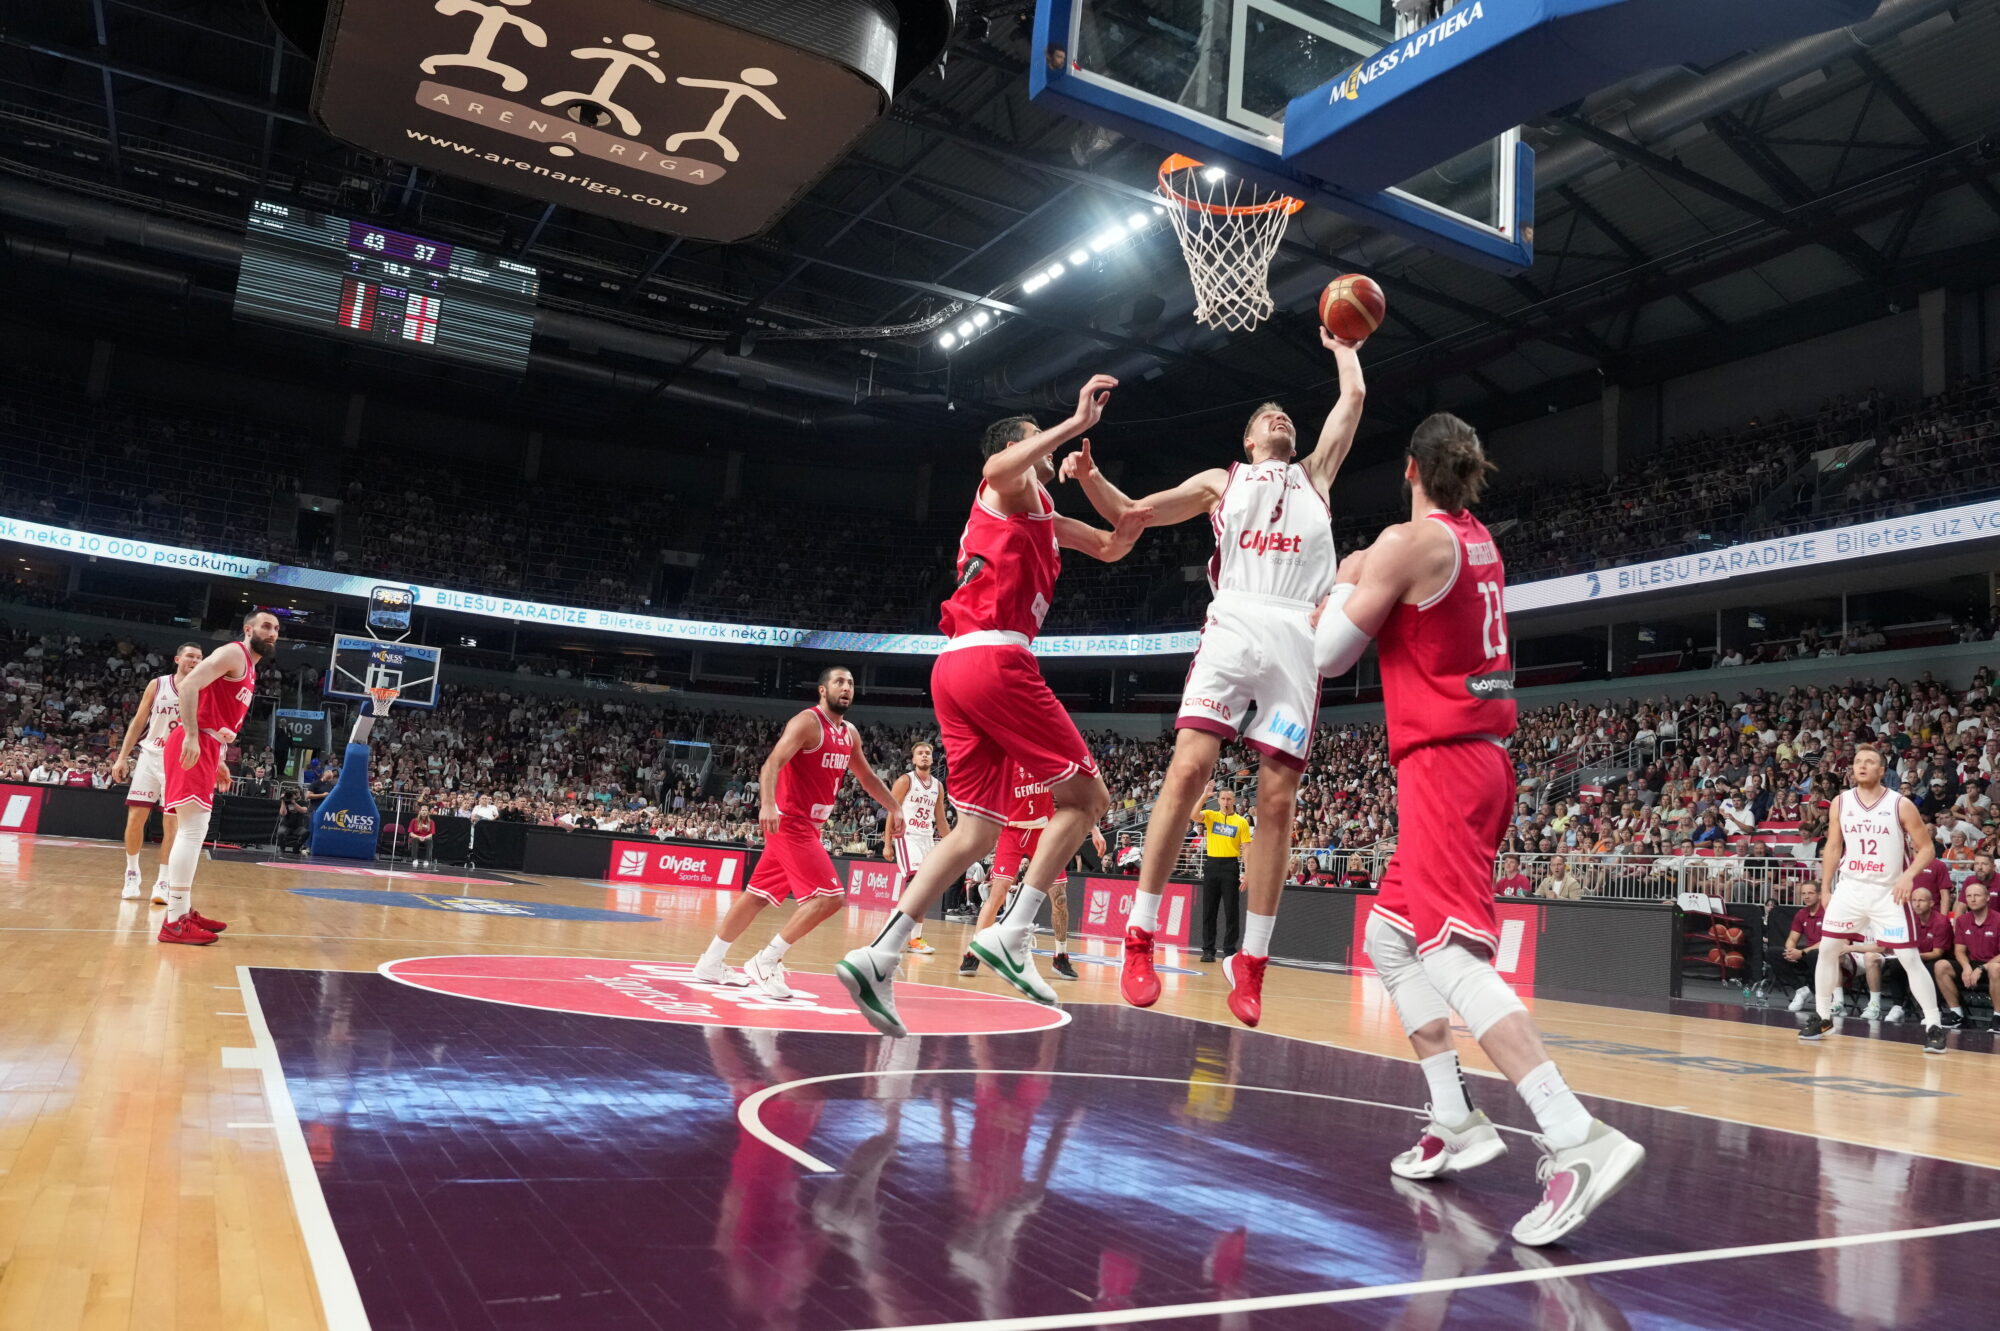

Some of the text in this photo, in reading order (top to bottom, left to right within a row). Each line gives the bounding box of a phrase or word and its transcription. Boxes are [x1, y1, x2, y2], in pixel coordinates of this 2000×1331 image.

[1400, 1, 1484, 63] APTIEKA
[406, 128, 689, 214] www.arenariga.com
[609, 143, 706, 179] RĪGA
[363, 232, 436, 262] 43 37
[24, 527, 72, 548] nekā
[80, 534, 101, 551] 10
[108, 540, 148, 560] 000
[153, 549, 250, 576] pasākumu
[1239, 530, 1302, 556] OlyBet
[1698, 539, 1817, 577] PARADĪZE
[1836, 525, 1923, 556] Biļetes
[1932, 518, 1962, 538] uz
[502, 601, 588, 625] PARADĪZE
[657, 620, 674, 634] uz
[679, 621, 726, 639] vairāk
[731, 624, 767, 641] nekā
[772, 628, 789, 643] 10
[1086, 635, 1162, 653] PARADĪZE
[156, 703, 180, 716] LATV
[1184, 698, 1222, 713] CIRCLE
[287, 721, 313, 735] 108
[915, 807, 931, 821] 55
[1028, 800, 1034, 815] 5
[1844, 822, 1890, 836] LATVIJA
[1859, 838, 1878, 856] 12
[658, 854, 708, 874] OlyBet
[1849, 859, 1885, 873] OlyBet
[867, 872, 889, 892] OlyBet
